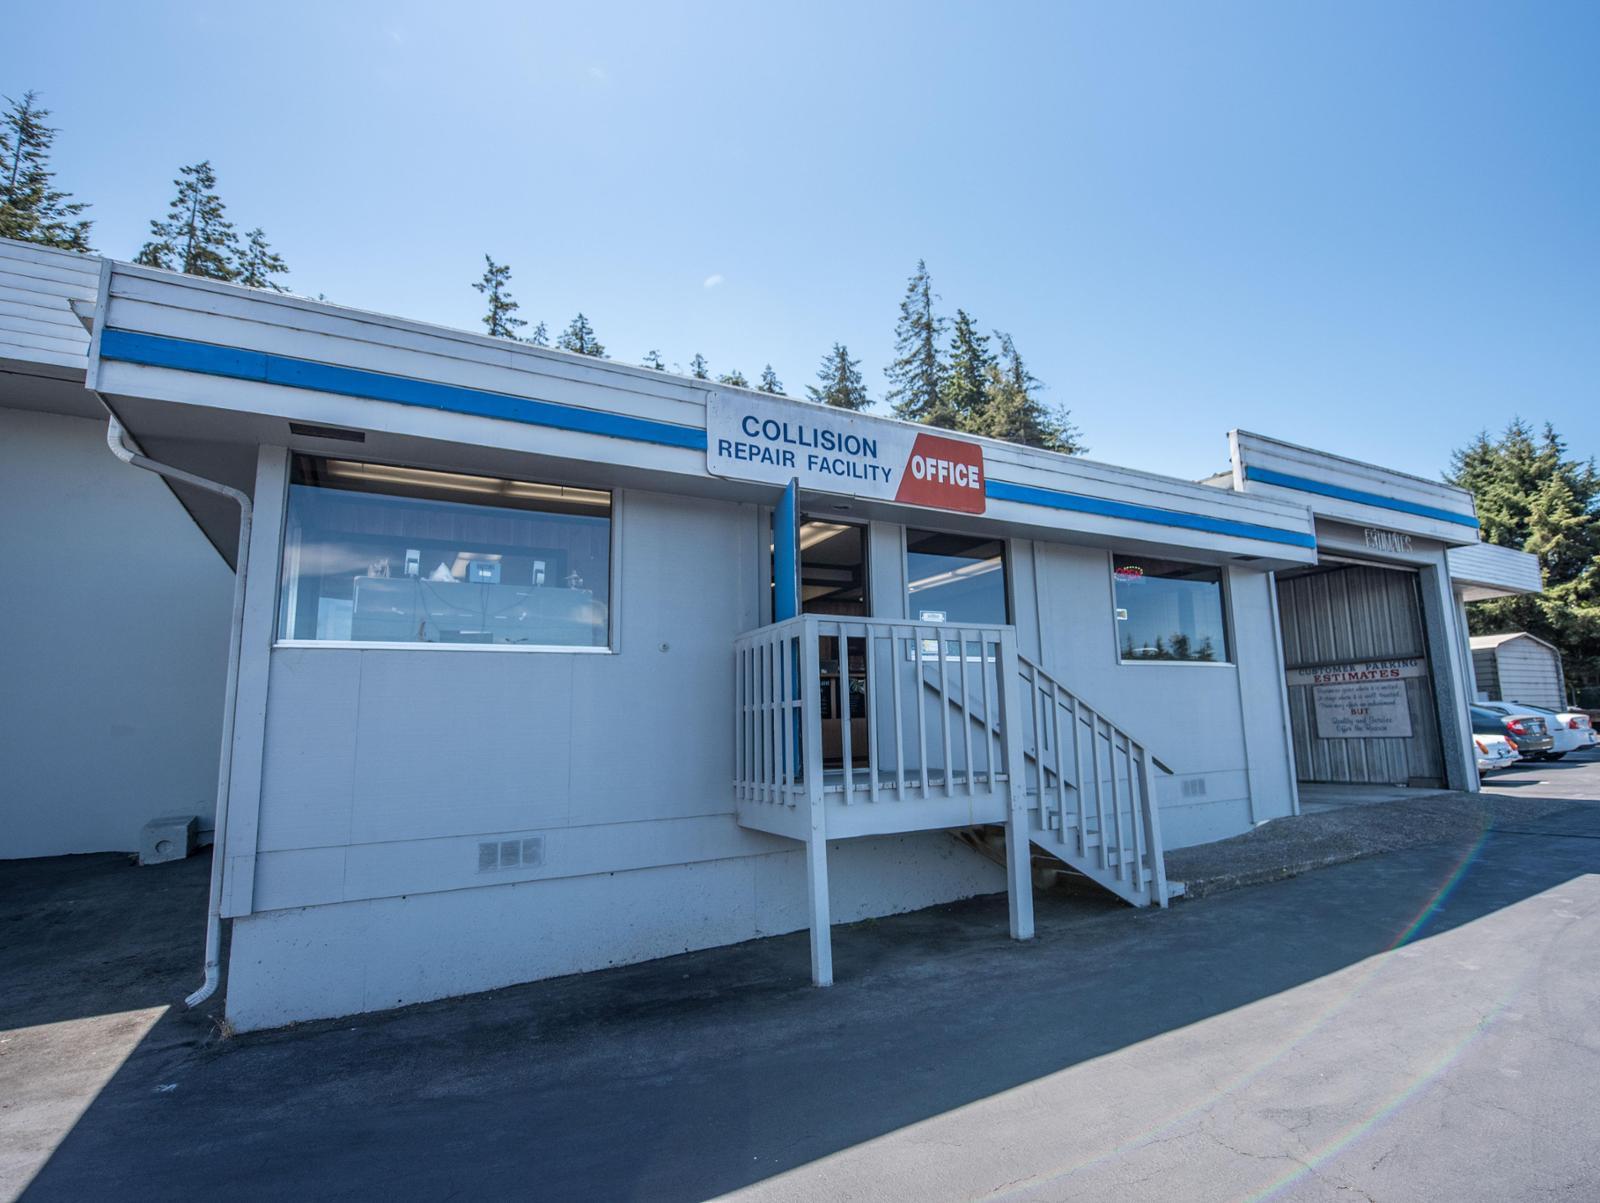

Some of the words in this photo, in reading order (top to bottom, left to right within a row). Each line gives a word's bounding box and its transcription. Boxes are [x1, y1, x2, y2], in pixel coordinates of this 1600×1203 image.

[741, 415, 877, 459] COLLISION
[718, 438, 795, 468] REPAIR
[807, 454, 892, 484] FACILITY
[911, 454, 980, 489] OFFICE
[1298, 663, 1357, 676] CUSTOMER
[1365, 659, 1418, 672] PARKING
[1313, 668, 1400, 684] ESTIMATES
[1350, 707, 1369, 715] BUT
